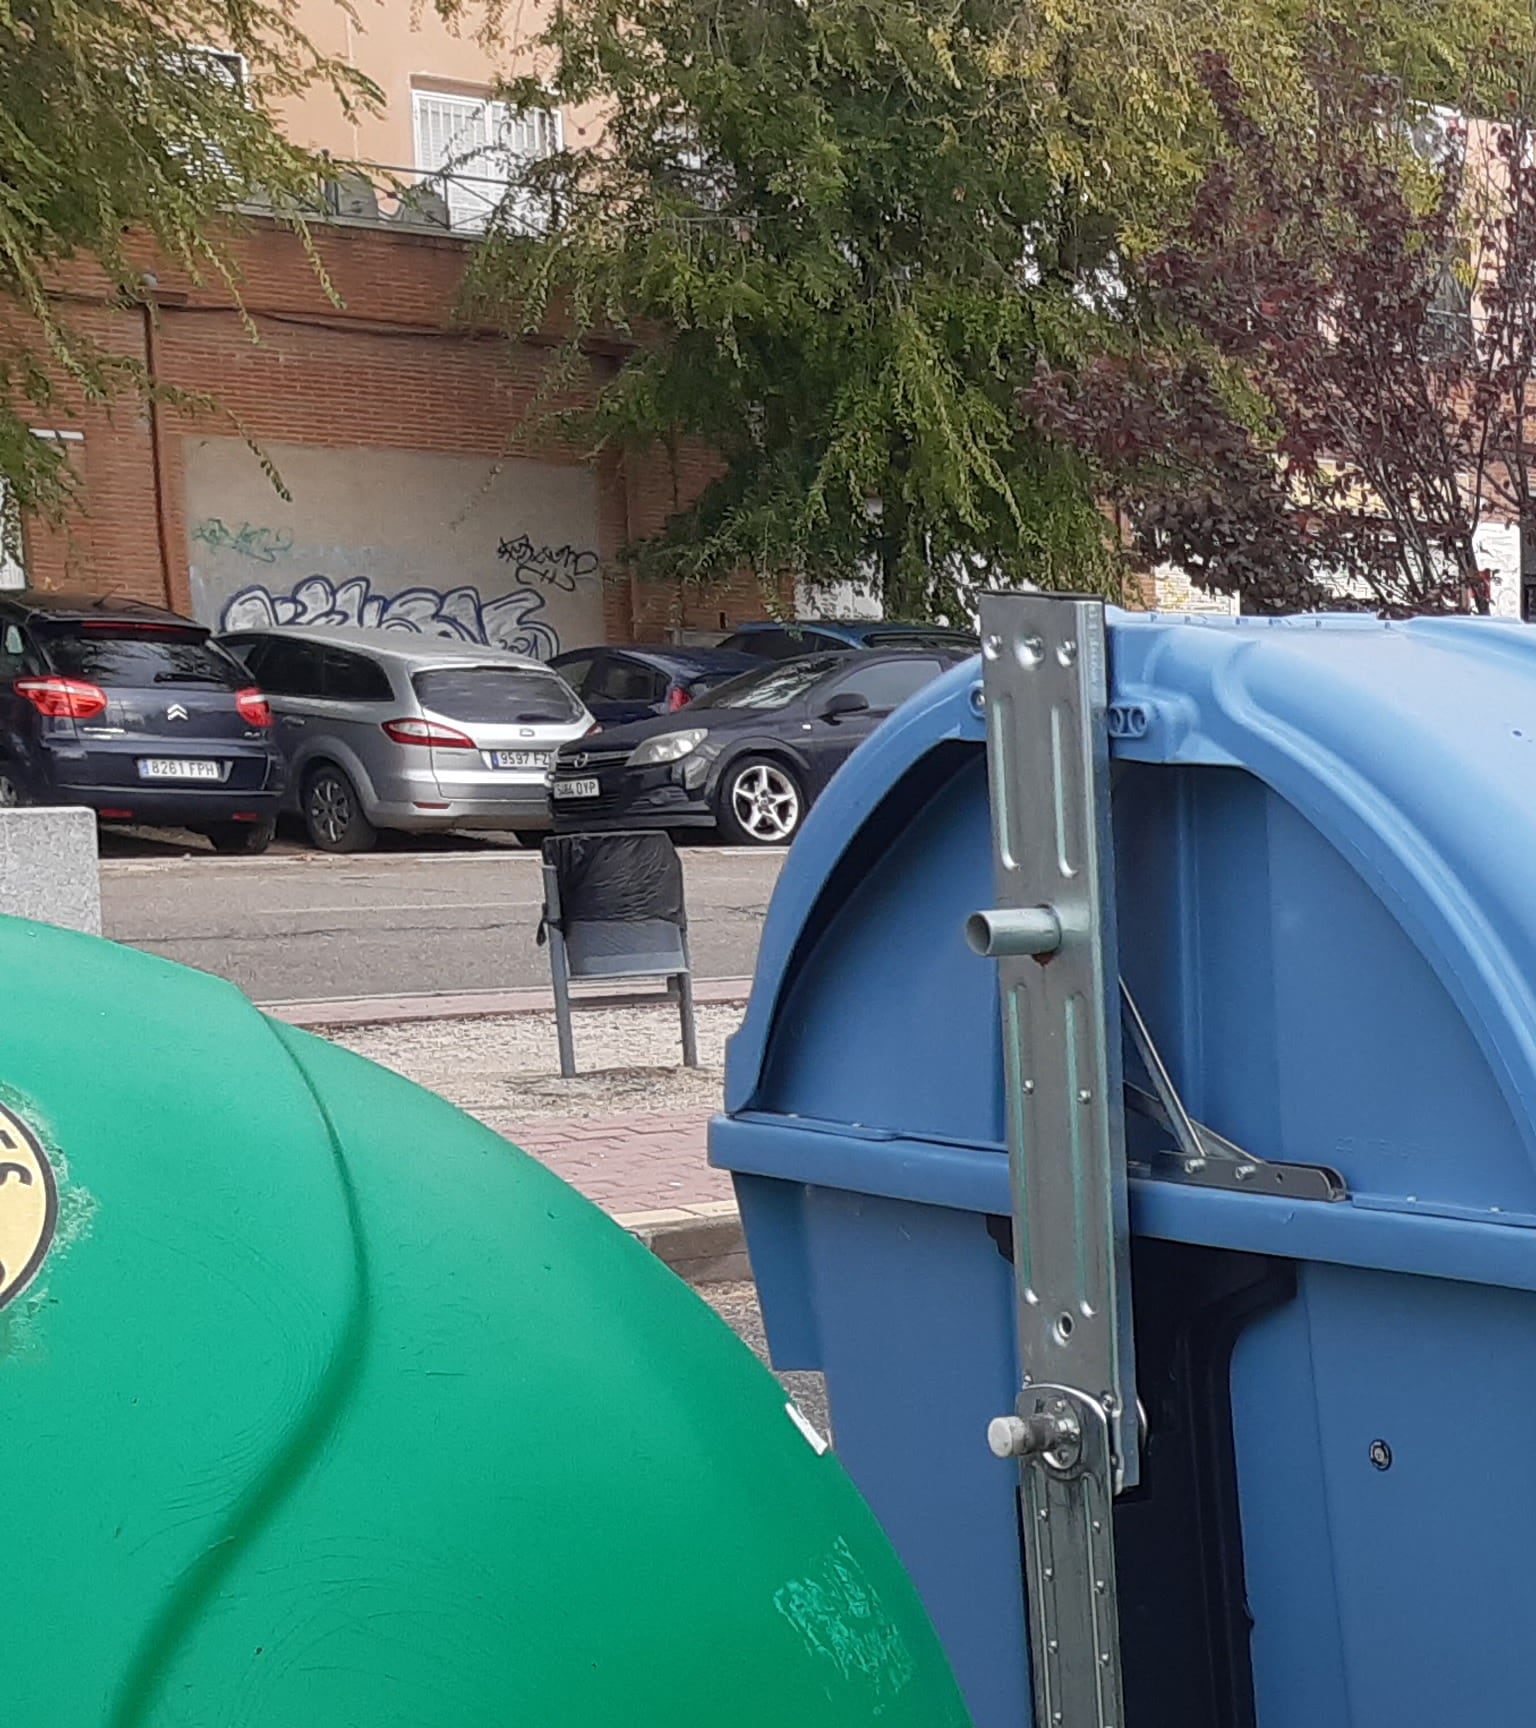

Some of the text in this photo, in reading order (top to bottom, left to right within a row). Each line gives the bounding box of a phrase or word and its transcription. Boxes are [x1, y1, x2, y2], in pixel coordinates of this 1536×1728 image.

[500, 751, 530, 765] 9597
[151, 760, 215, 777] 8261 FPH
